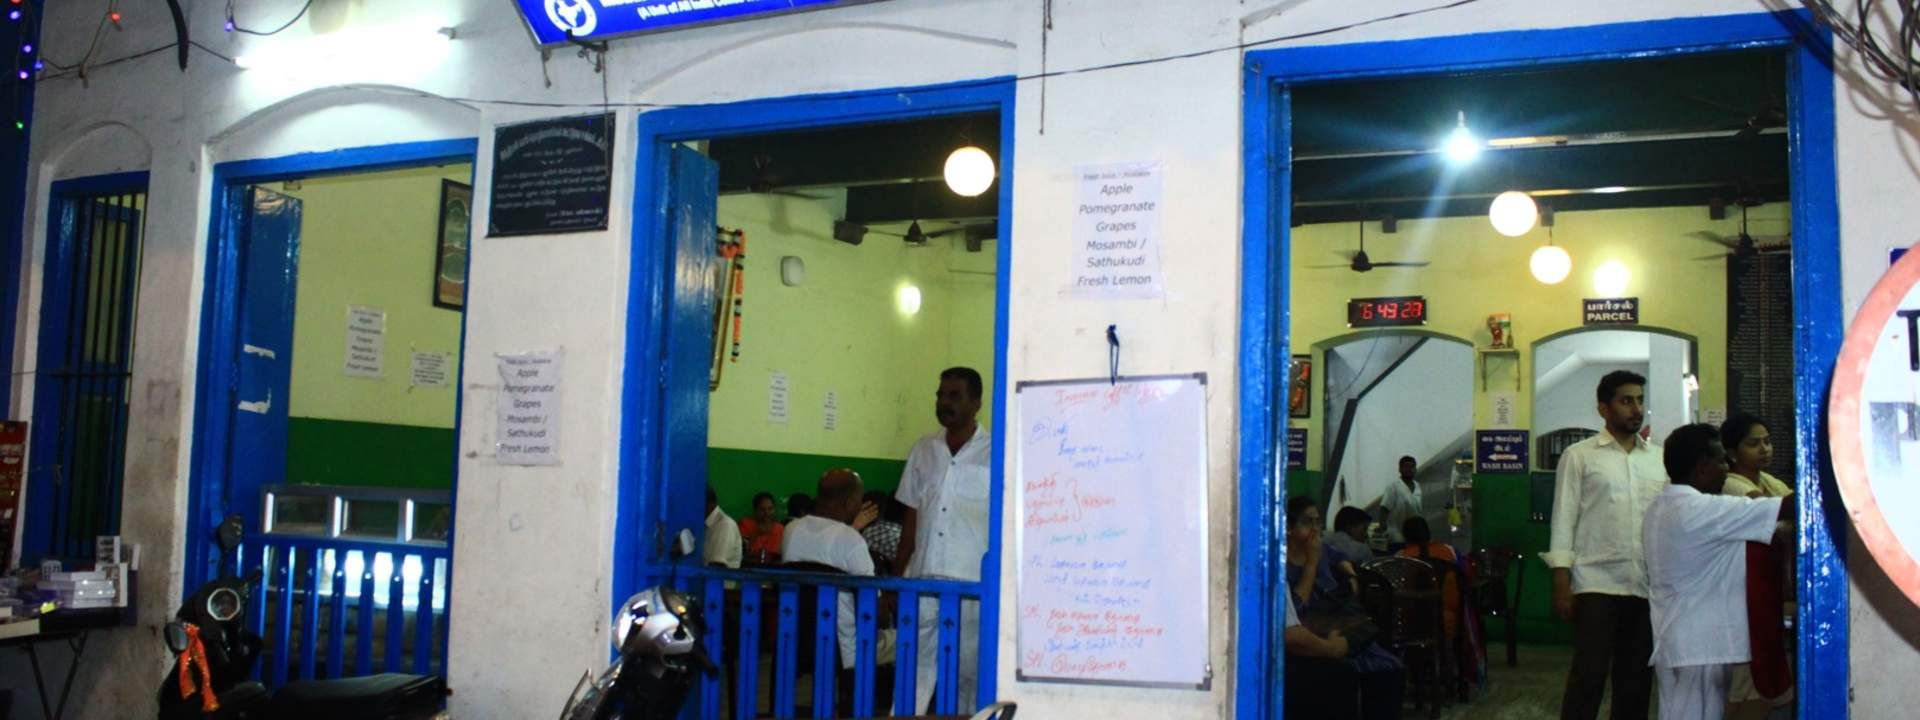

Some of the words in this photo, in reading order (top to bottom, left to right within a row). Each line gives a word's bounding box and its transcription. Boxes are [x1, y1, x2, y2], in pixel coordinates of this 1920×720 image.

[1100, 184, 1133, 196] Apple
[1079, 200, 1155, 215] Pomegranate
[1095, 220, 1136, 233] Grapes
[1086, 239, 1137, 251] Mosambi
[1087, 255, 1145, 268] Sathukudi
[1077, 275, 1109, 287] Fresh
[1112, 274, 1152, 286] Lemon
[1587, 312, 1634, 321] PARCEL
